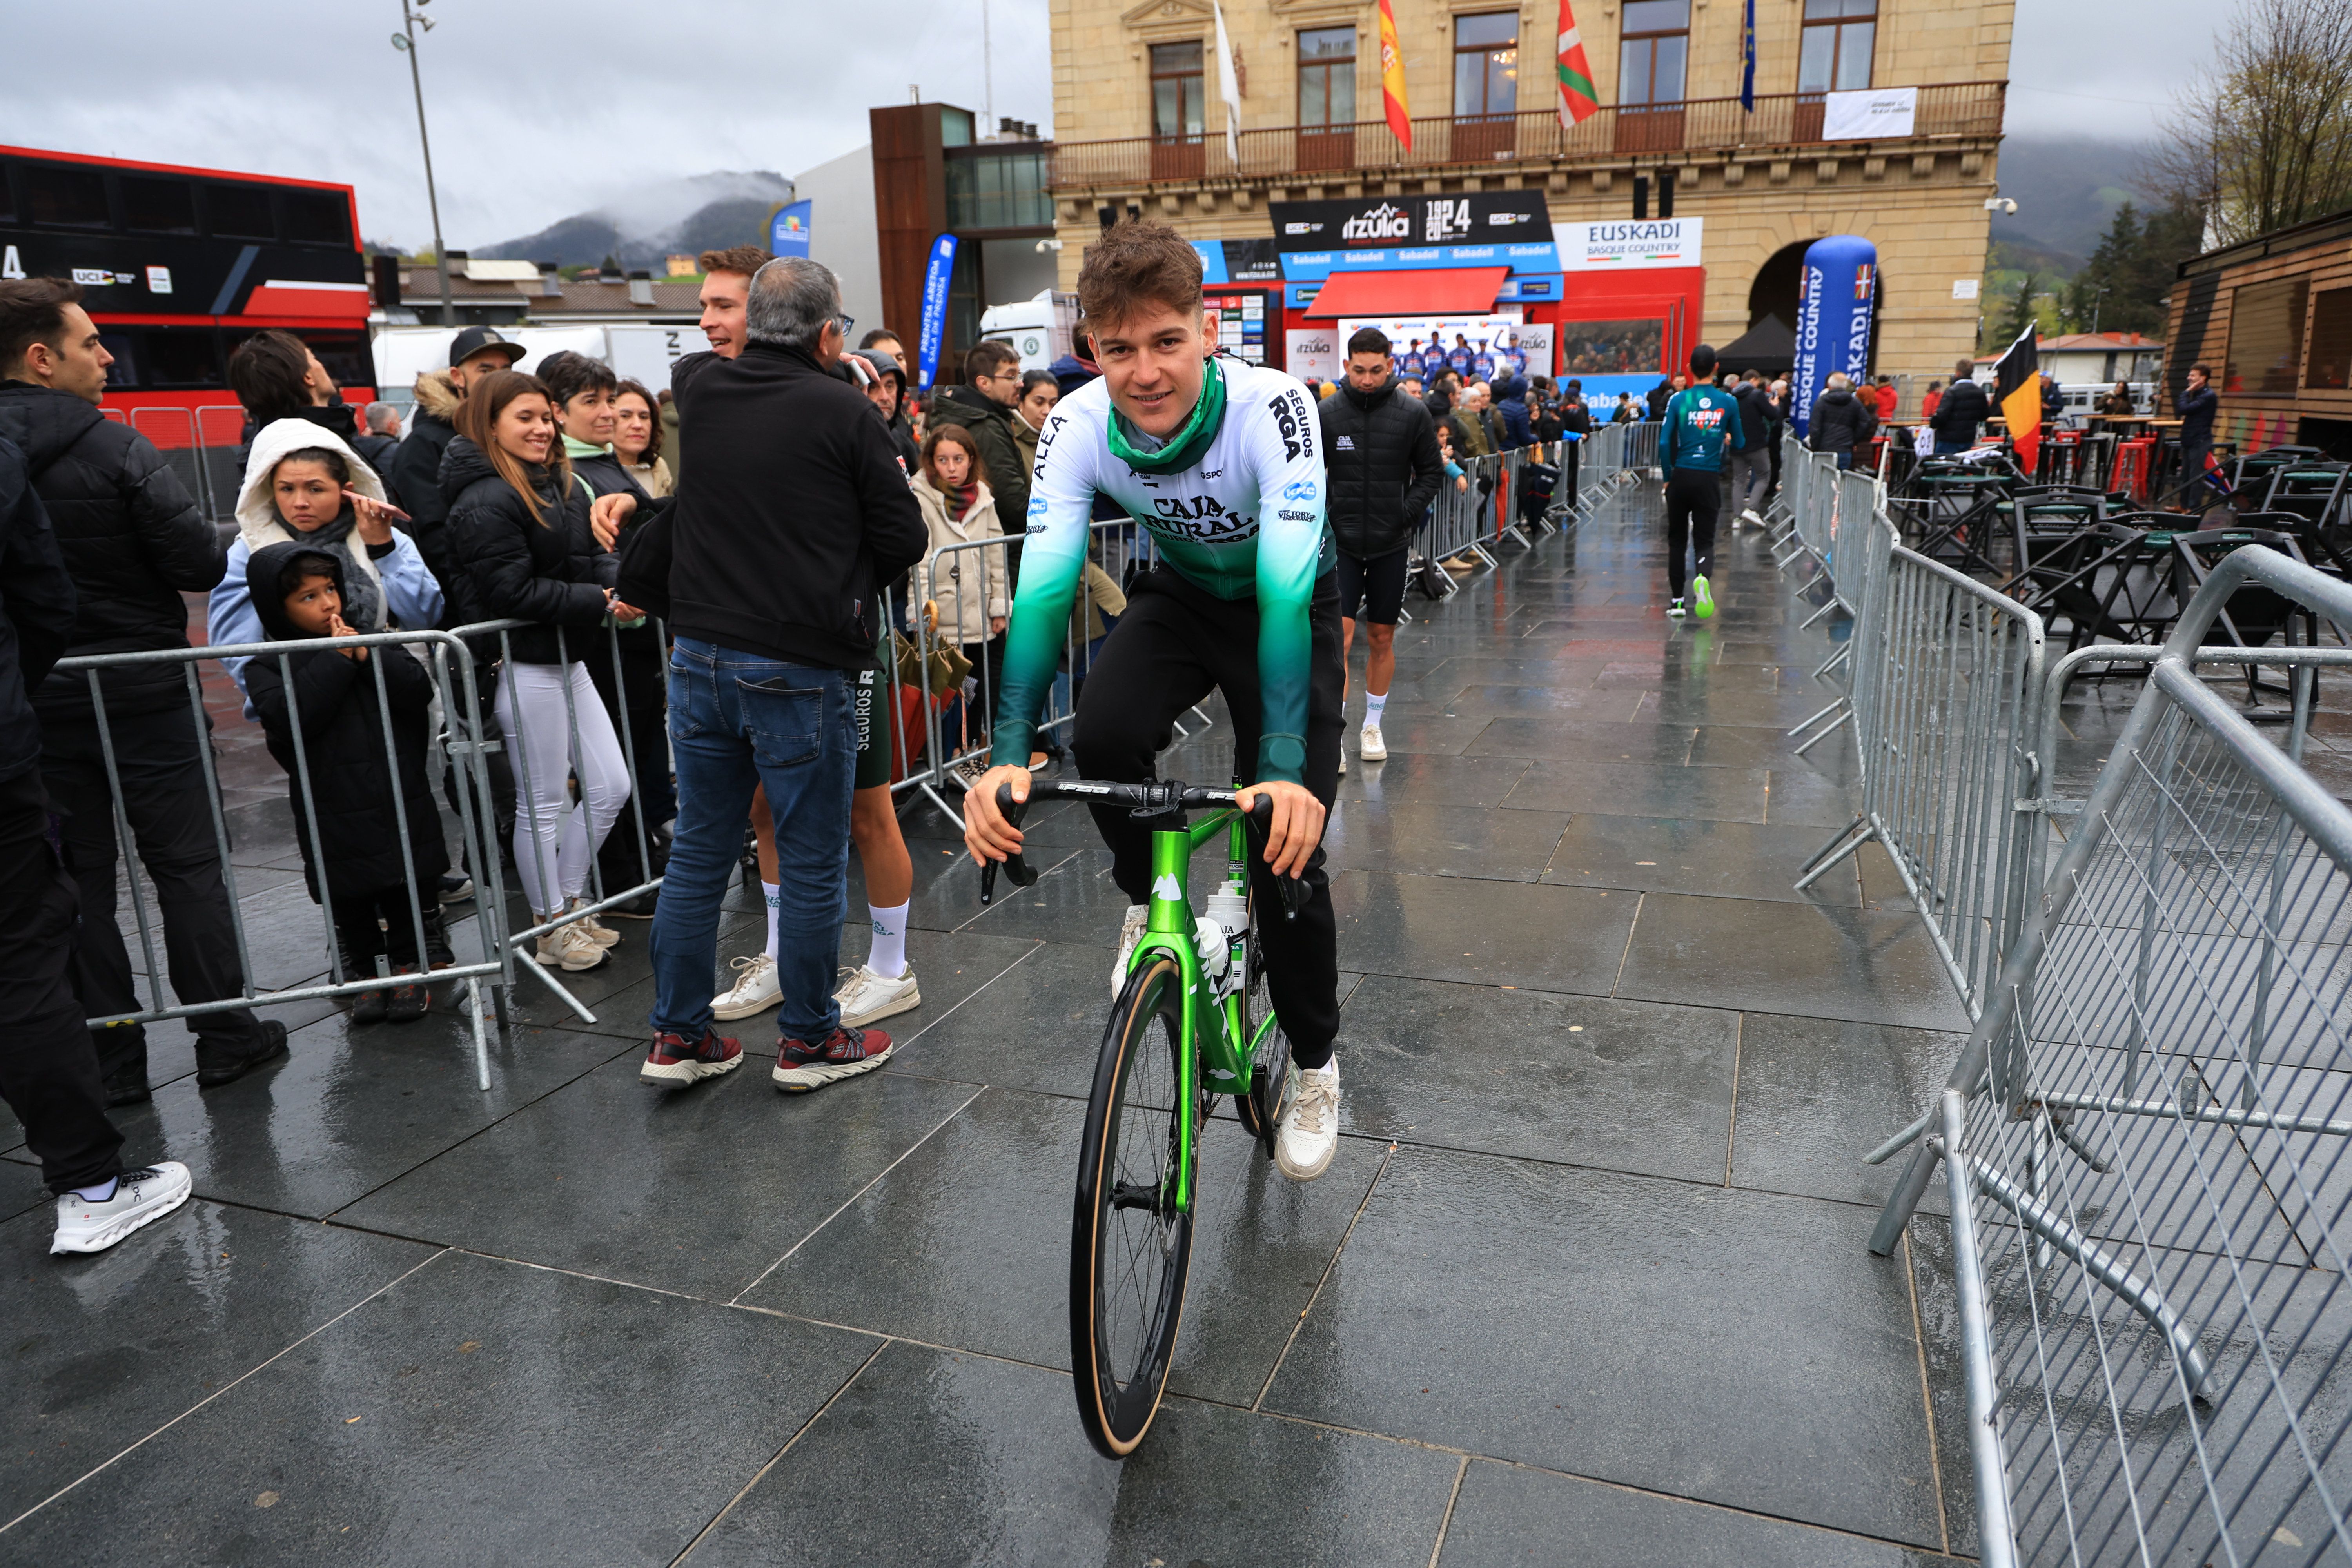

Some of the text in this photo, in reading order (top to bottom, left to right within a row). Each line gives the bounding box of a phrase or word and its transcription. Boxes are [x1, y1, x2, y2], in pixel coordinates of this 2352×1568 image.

[1589, 221, 1681, 242] EUSKADI
[1345, 251, 1384, 263] Sabadell
[1399, 249, 1439, 261] Sabadell
[1453, 247, 1494, 259] Sabadell
[1510, 245, 1551, 256] Sabadell
[1588, 242, 1681, 254] BASQUE COUNTRY
[1293, 254, 1331, 265] Sabadell
[78, 272, 99, 281] UCI
[931, 319, 940, 335] DE
[928, 337, 938, 364] SALA
[1798, 266, 1824, 421] BASQUE COUNTRY
[1847, 306, 1869, 389] SKADI
[1286, 389, 1313, 458] SEGUROS
[1688, 411, 1722, 421] KERN
[1268, 395, 1301, 463] RGA
[1034, 416, 1069, 481] ALEA
[1286, 486, 1315, 497] KMC
[1153, 495, 1226, 519] CAJA
[1140, 512, 1254, 538] RURAL
[856, 689, 872, 751] SEGUROS
